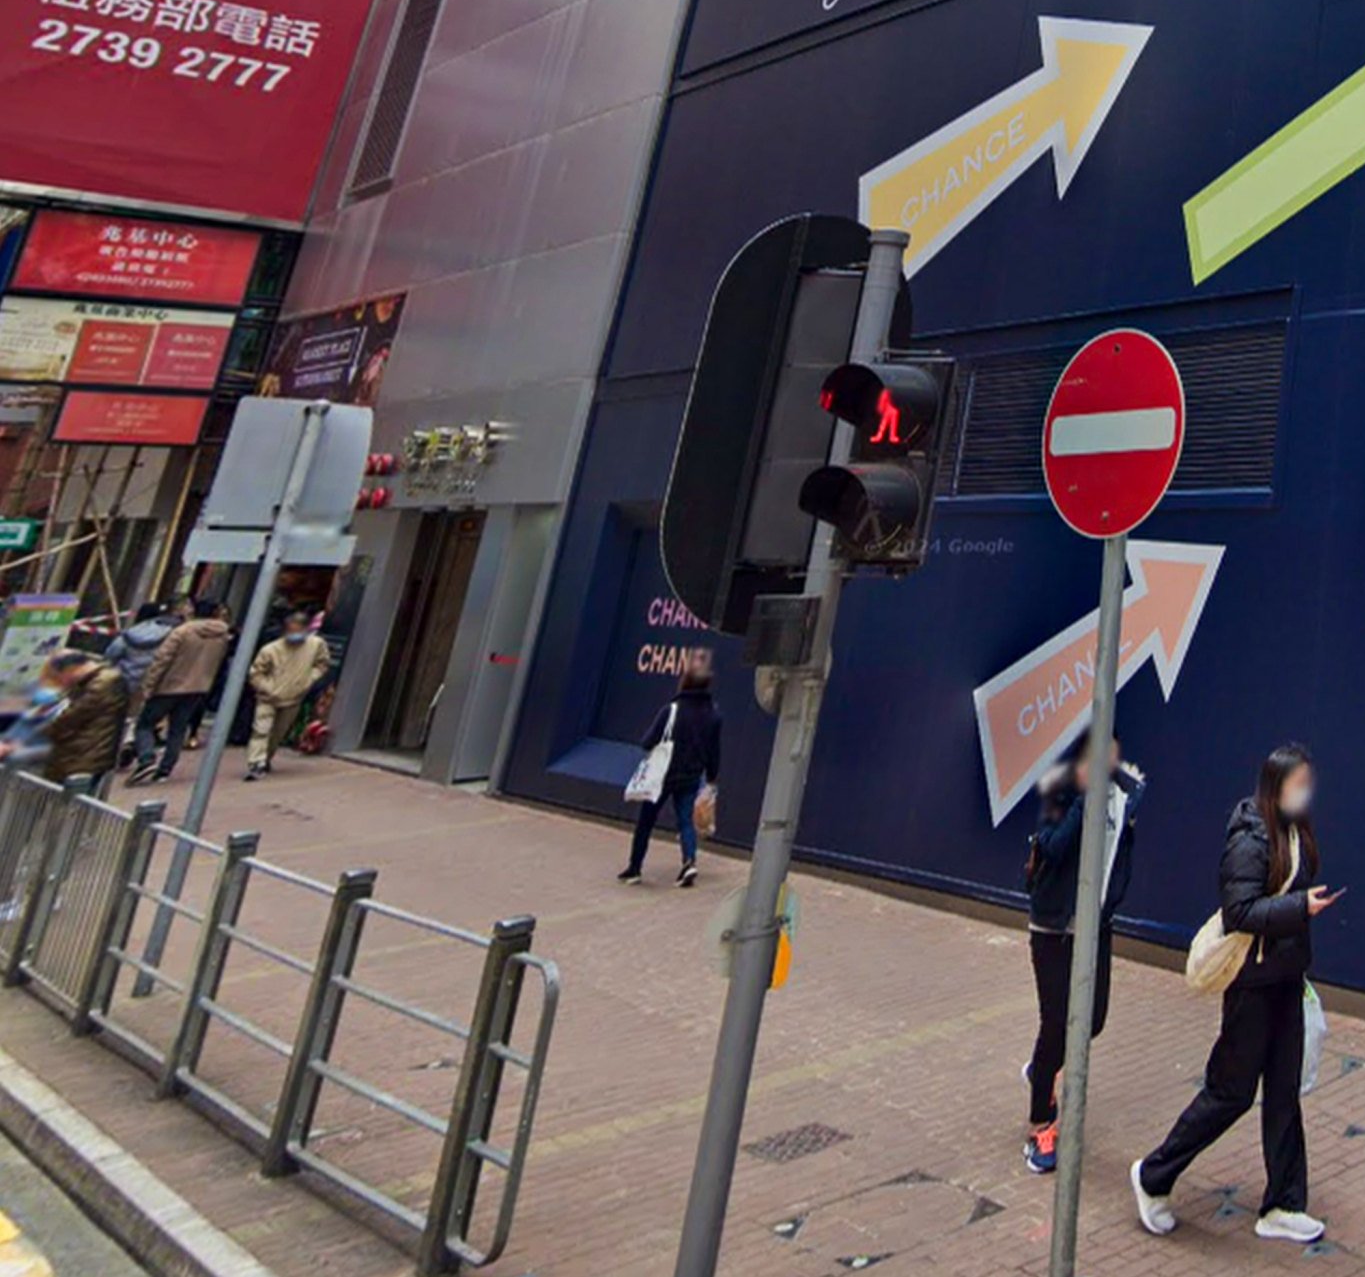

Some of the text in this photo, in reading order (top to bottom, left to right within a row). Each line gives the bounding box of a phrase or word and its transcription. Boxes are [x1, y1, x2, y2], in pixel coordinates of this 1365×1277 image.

[31, 18, 292, 94] 2739 2777
[899, 110, 1027, 229] CHANCE
[647, 596, 710, 630] CHAN
[637, 642, 714, 676] CHAN
[1016, 635, 1135, 738] CHAN
